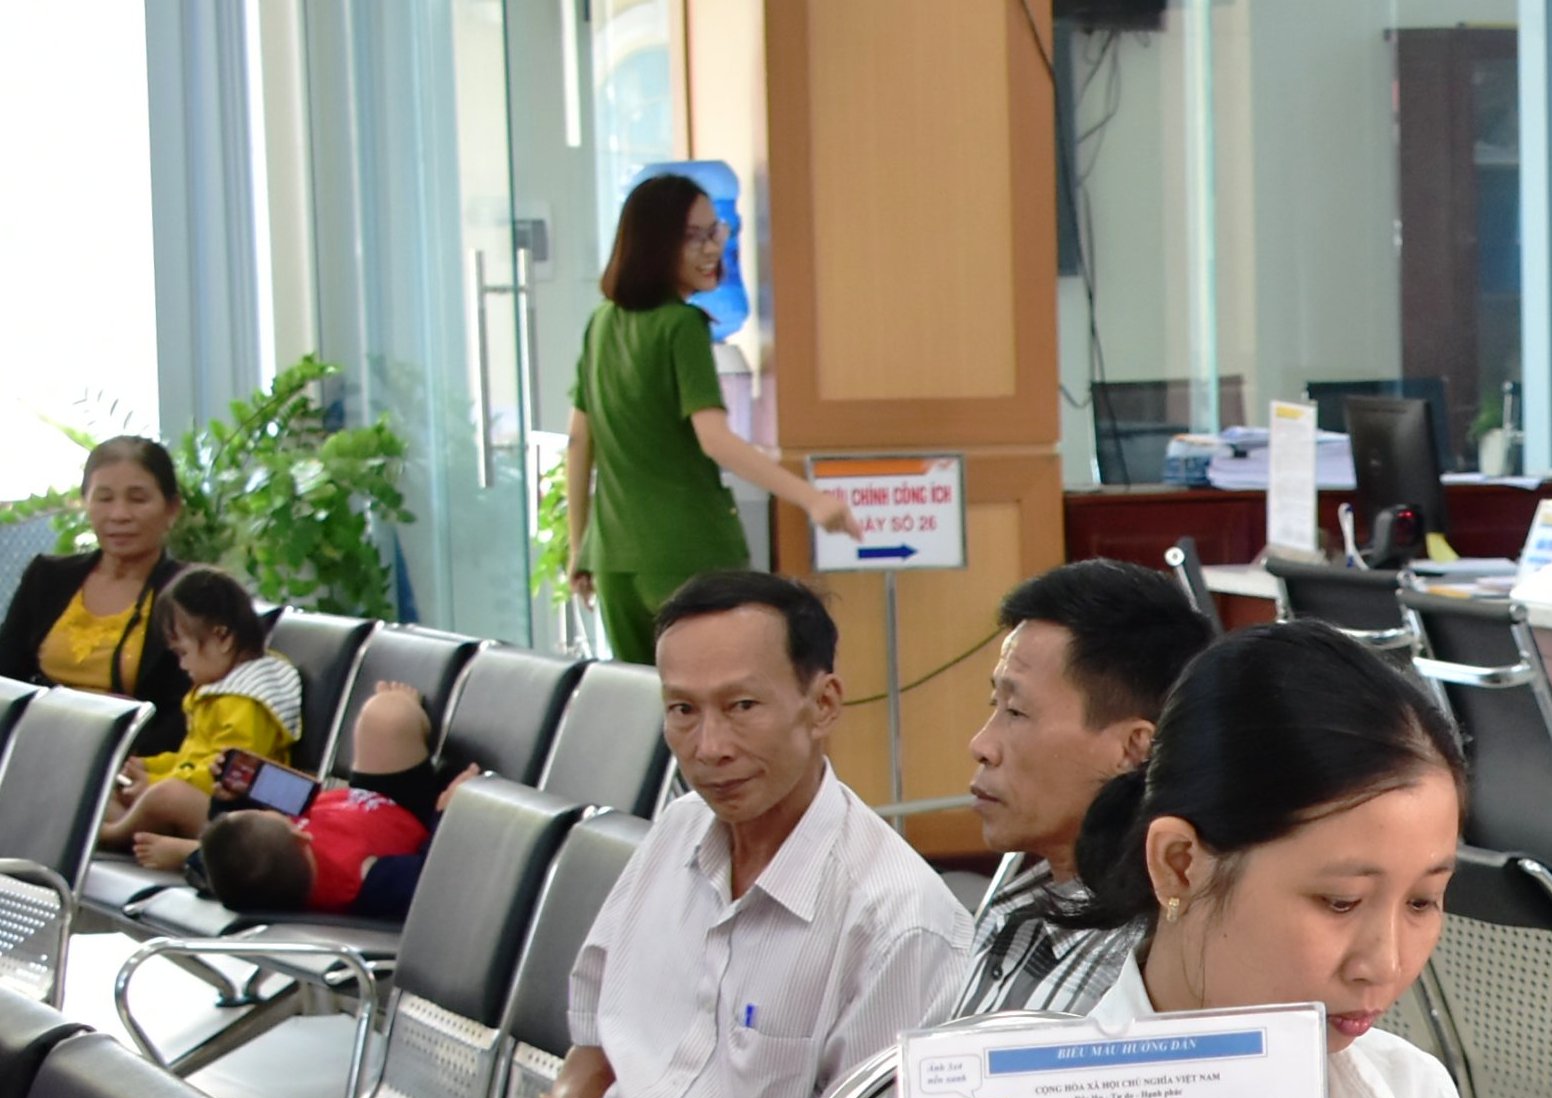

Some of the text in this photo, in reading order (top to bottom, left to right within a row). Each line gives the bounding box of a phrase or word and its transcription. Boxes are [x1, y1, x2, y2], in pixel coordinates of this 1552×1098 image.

[852, 480, 889, 507] CHÍNH
[893, 480, 927, 506] CÔNG
[930, 480, 952, 504] ÍCH
[1057, 1036, 1197, 1059] BIỂU MẪU HƯỚNG DẪN
[1035, 1073, 1220, 1095] CỘNG HÒA XÃ HỘI CHỦ NGHĨA VIỆT NAM
